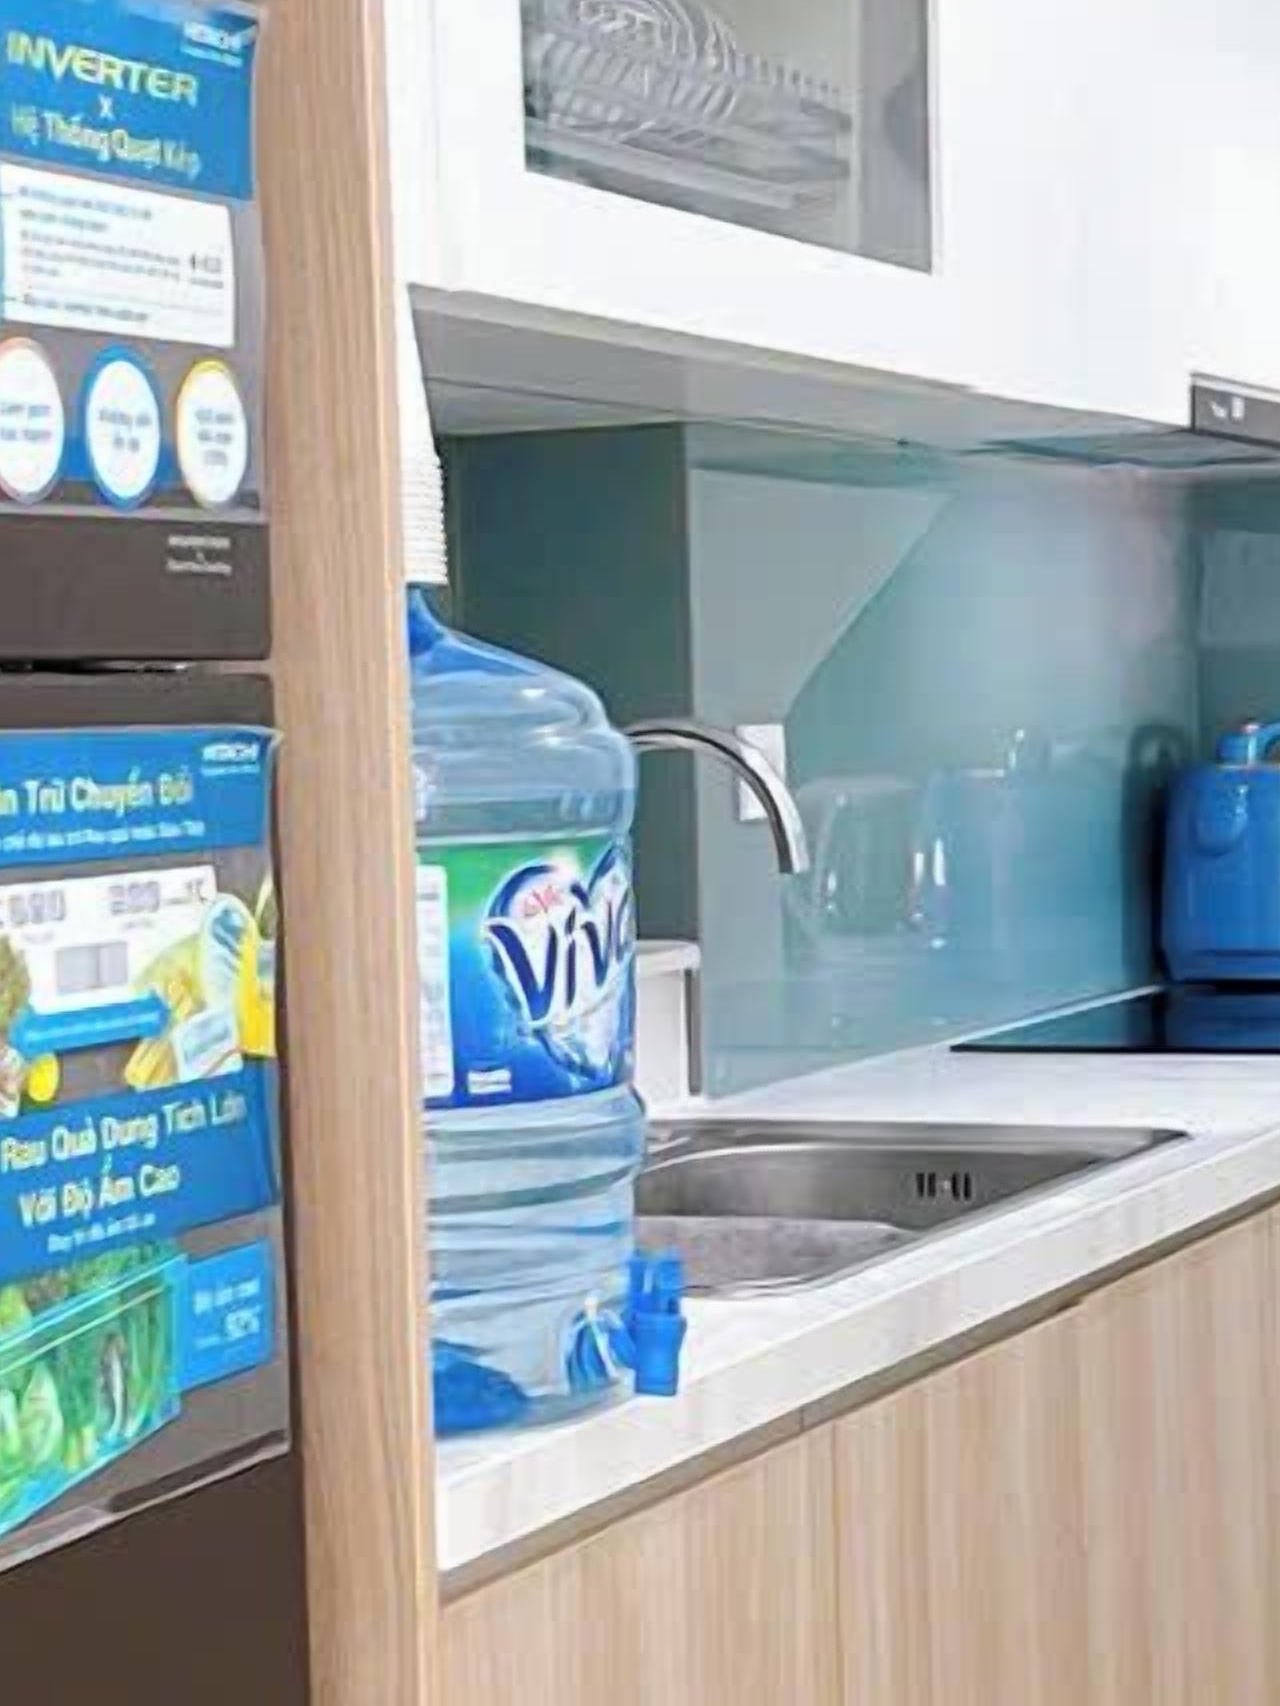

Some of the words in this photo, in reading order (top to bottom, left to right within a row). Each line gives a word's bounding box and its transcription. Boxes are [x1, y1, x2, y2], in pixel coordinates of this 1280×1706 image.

[7, 29, 199, 108] INVERTER
[0, 1137, 48, 1173] Rau
[100, 1113, 158, 1149] Dung
[139, 1164, 181, 1197] Cao
